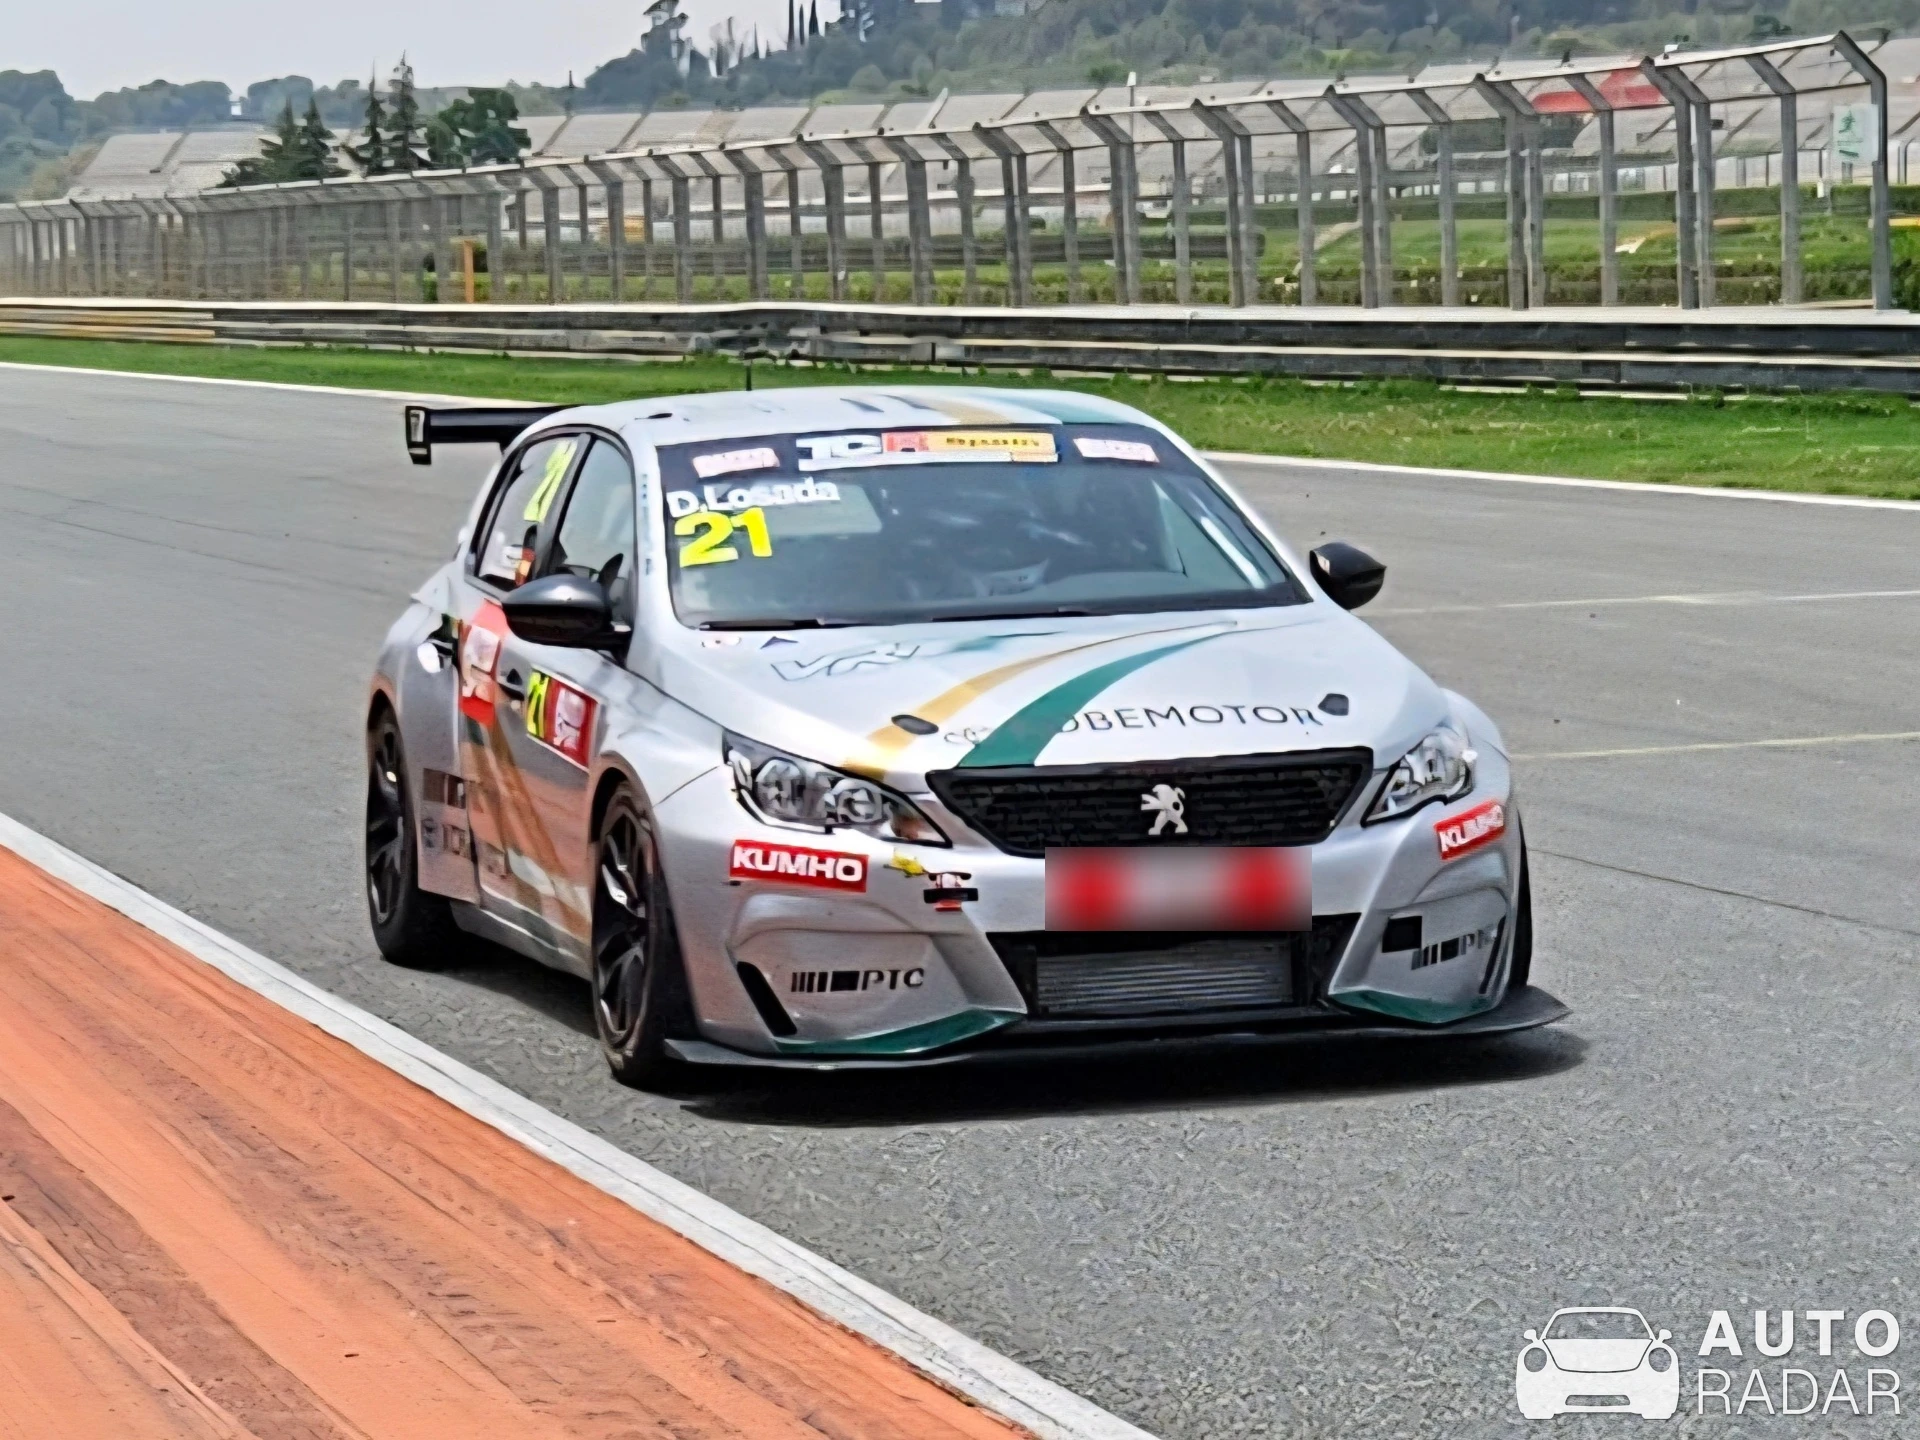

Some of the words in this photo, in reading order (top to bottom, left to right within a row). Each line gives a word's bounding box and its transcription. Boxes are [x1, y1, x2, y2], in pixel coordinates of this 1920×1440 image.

[674, 507, 773, 568] 21
[733, 845, 863, 883] KUMHO
[861, 967, 925, 991] PTC
